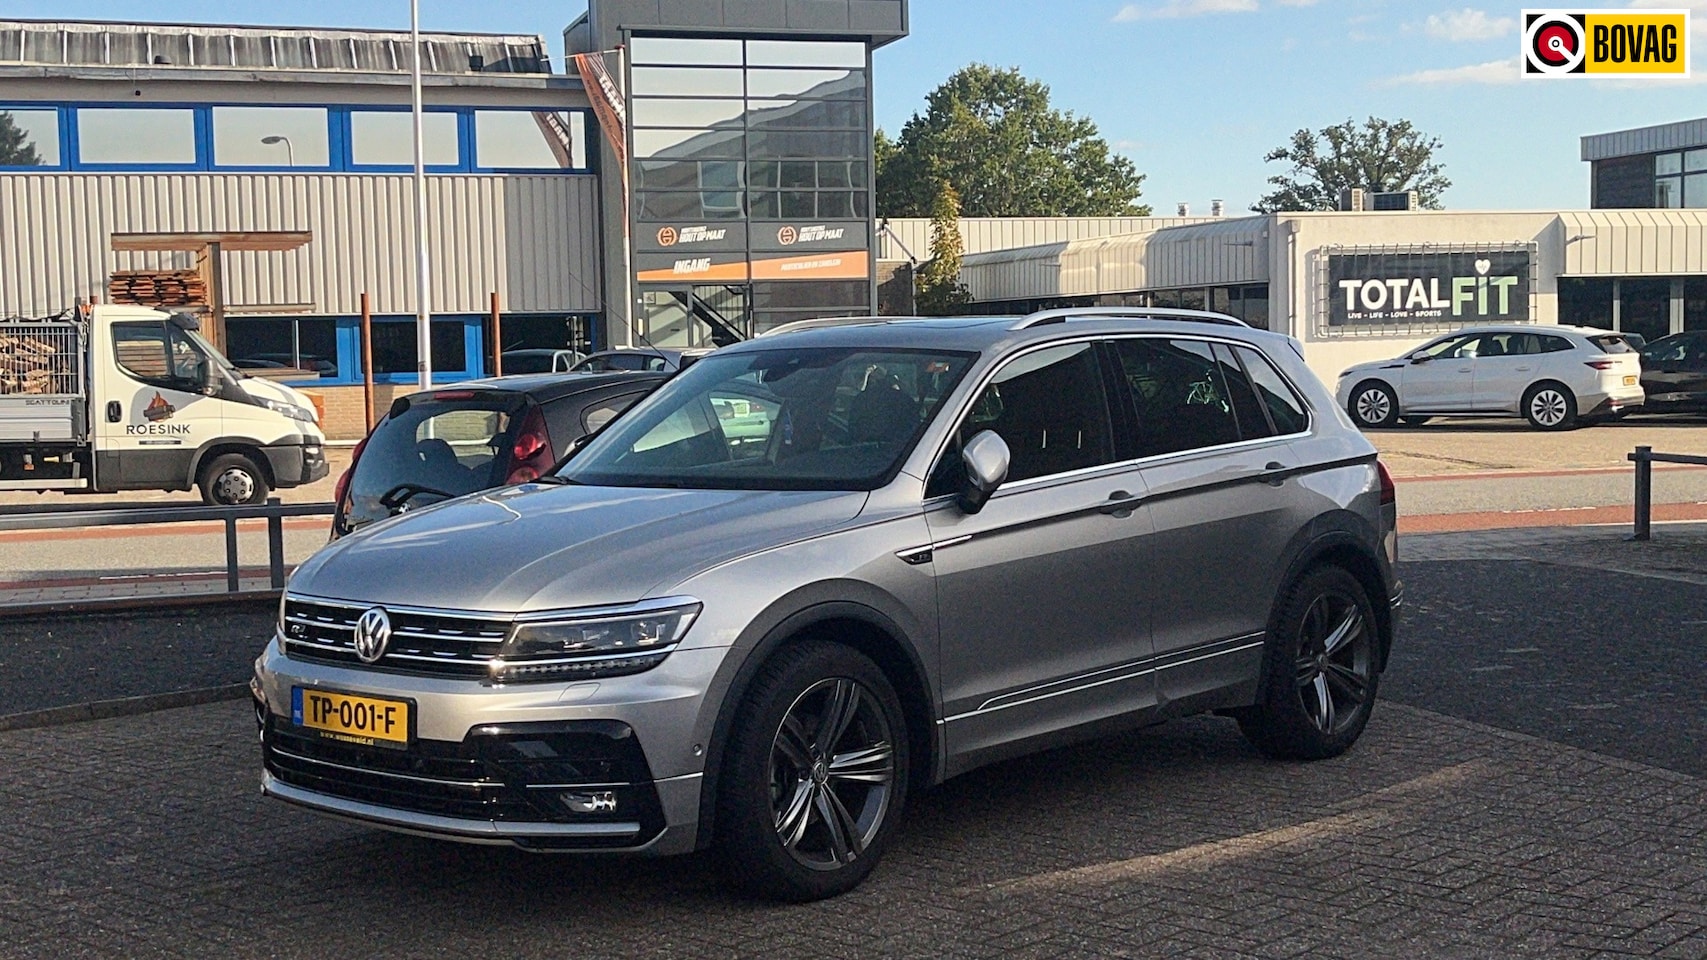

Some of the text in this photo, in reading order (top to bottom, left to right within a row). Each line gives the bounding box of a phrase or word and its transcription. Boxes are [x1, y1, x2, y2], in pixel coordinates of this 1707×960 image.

[673, 257, 711, 274] INGANG
[1390, 310, 1408, 318] LOVE
[126, 424, 191, 435] ROESINK
[310, 695, 397, 734] TP-001-F
